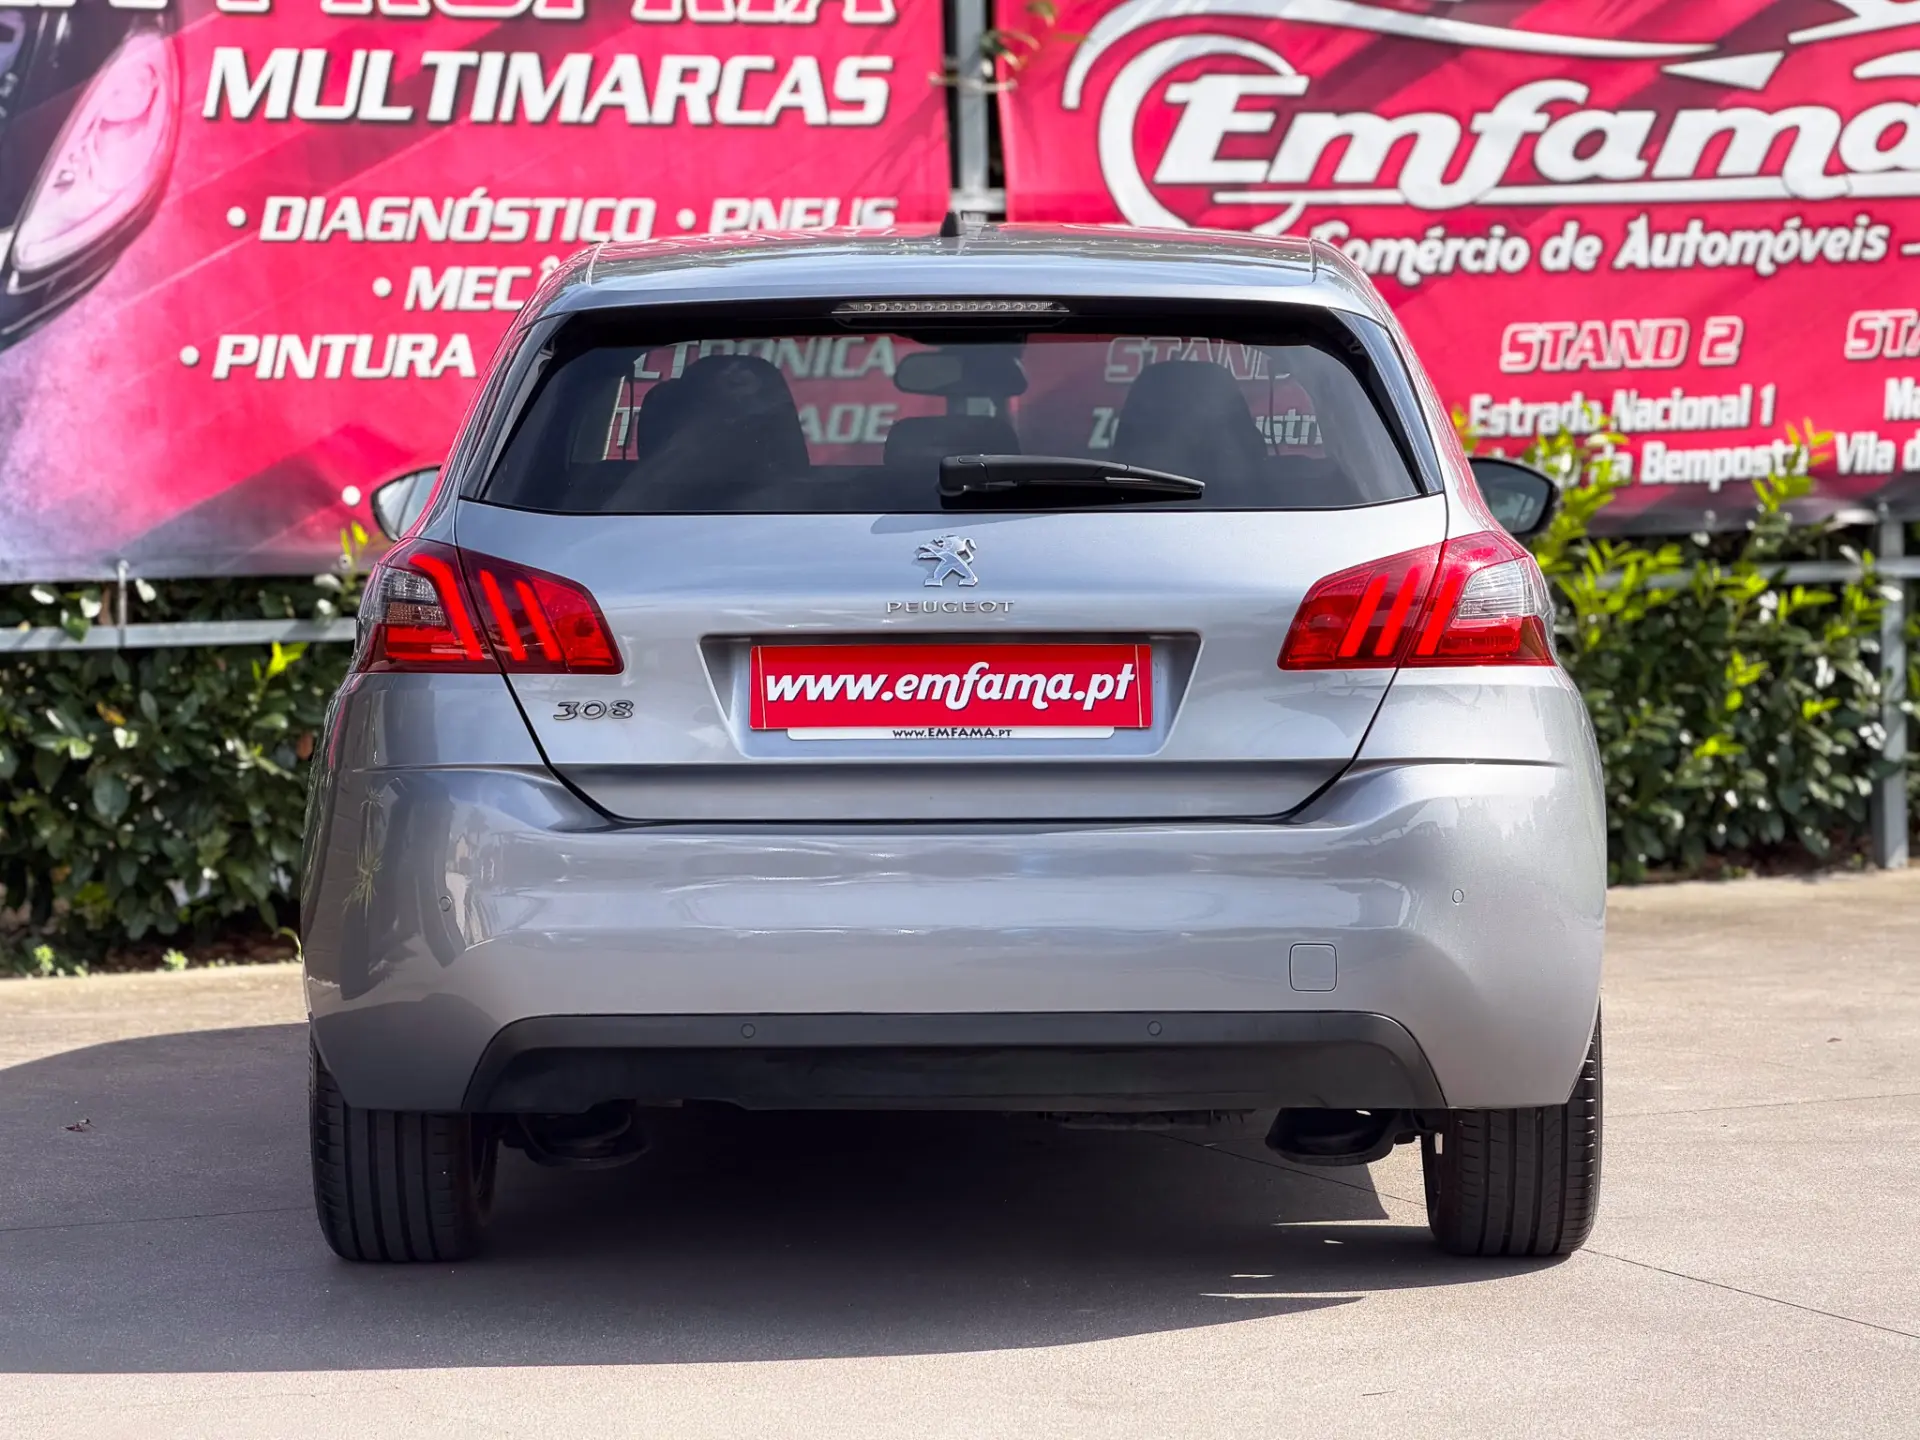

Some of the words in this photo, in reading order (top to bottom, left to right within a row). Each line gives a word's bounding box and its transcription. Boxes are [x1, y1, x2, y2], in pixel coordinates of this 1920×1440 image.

[203, 47, 893, 126] MULTIMARCAS
[1153, 74, 1920, 208] Emfama
[259, 187, 656, 243] DIAGNÓSTICO
[1541, 220, 1602, 271] de
[1613, 213, 1890, 277] Automóveis
[212, 333, 478, 380] PINTURA
[1500, 318, 1690, 373] STAND
[1699, 316, 1744, 365] 2
[1611, 383, 1755, 433] Nacional
[1759, 383, 1776, 427] 1
[1835, 431, 1896, 474] Vila
[886, 600, 1014, 613] PEUGEOT
[552, 699, 634, 721] 308
[766, 661, 1136, 711] www.emfama.pt
